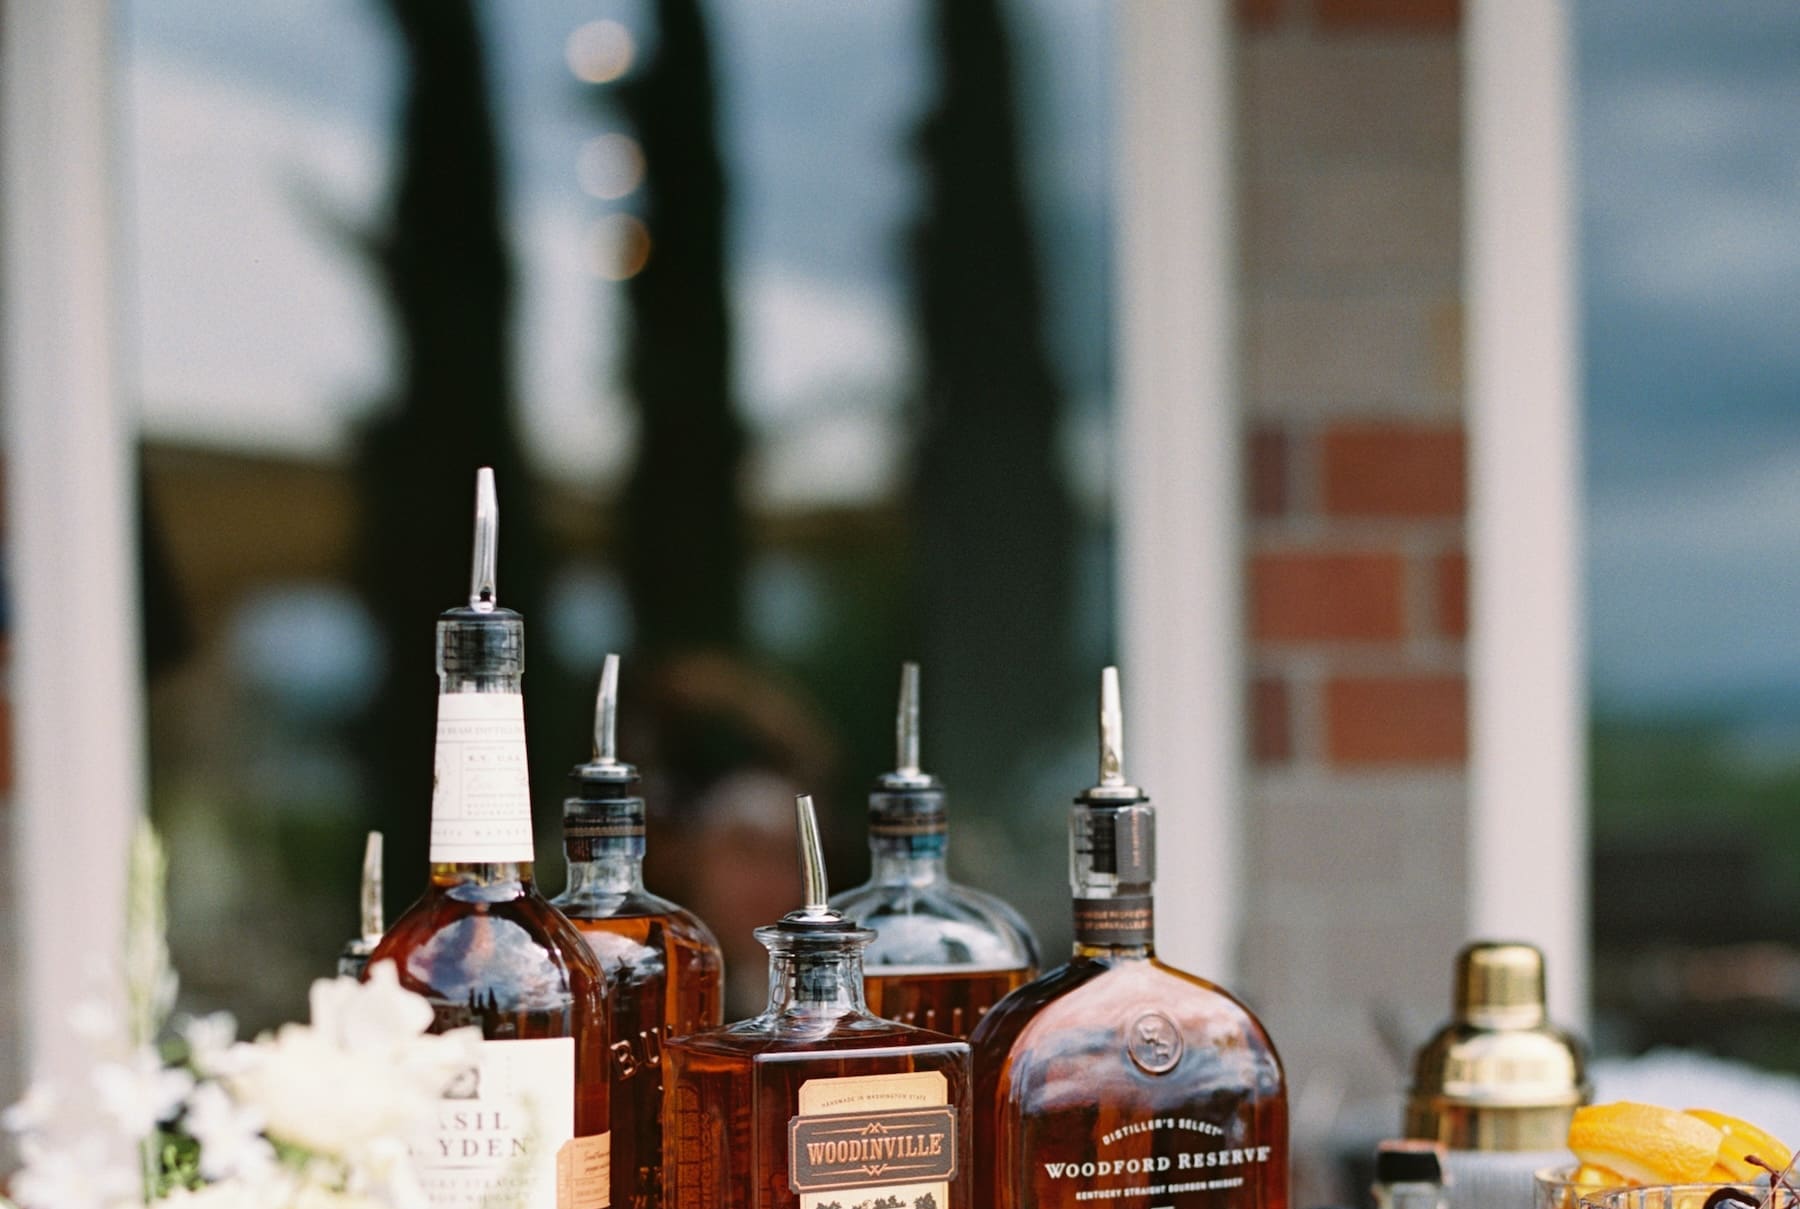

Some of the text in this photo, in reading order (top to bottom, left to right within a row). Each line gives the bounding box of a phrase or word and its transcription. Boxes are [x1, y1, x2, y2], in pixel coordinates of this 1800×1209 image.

[1102, 1118, 1221, 1146] DISTILLER'S SELECT
[807, 1133, 944, 1167] WOODINVILLE
[1045, 1146, 1270, 1179] WOODFORD RESERVE
[1076, 1188, 1122, 1201] KENTUCKY
[1124, 1185, 1166, 1198] STRAIGHT
[1168, 1181, 1207, 1194] BOURBON
